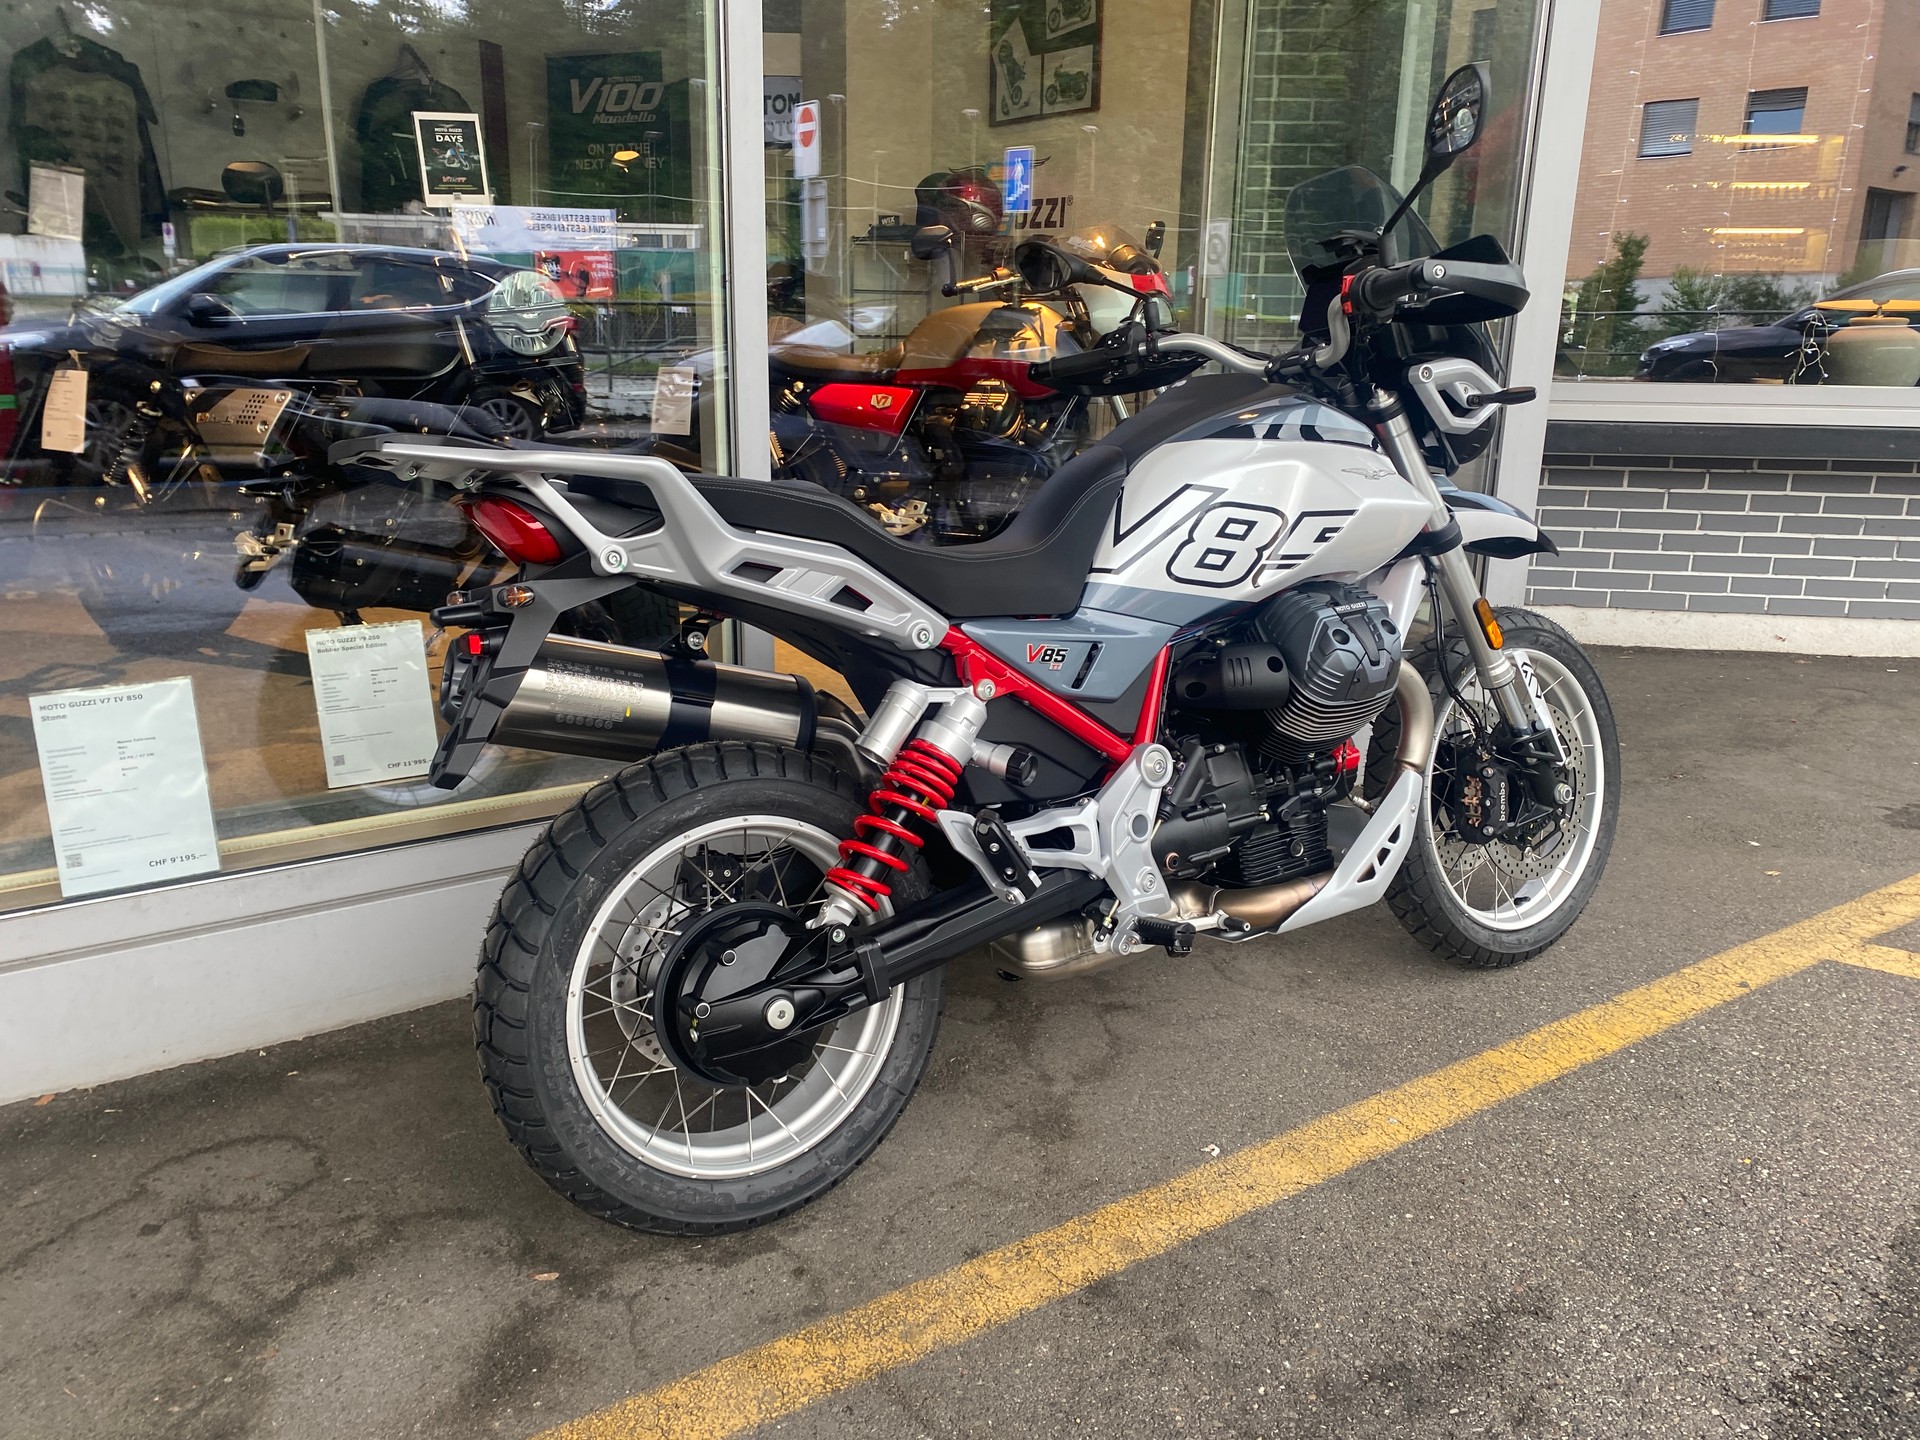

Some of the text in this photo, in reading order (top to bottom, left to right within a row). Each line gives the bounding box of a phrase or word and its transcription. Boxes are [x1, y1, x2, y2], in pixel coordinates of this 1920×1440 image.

[570, 77, 665, 114] V100
[592, 112, 656, 124] Mandello
[435, 134, 464, 143] DAYS
[588, 143, 605, 155] ON
[629, 142, 650, 154] THE
[575, 158, 605, 170] NEXT
[875, 395, 889, 405] V7
[341, 644, 364, 653] Special
[365, 641, 388, 649] Edition
[1027, 643, 1070, 663] V85
[39, 693, 143, 712] MOTO GUZZI V7 IV 850
[40, 713, 67, 722] Stone
[149, 857, 168, 867] CHF
